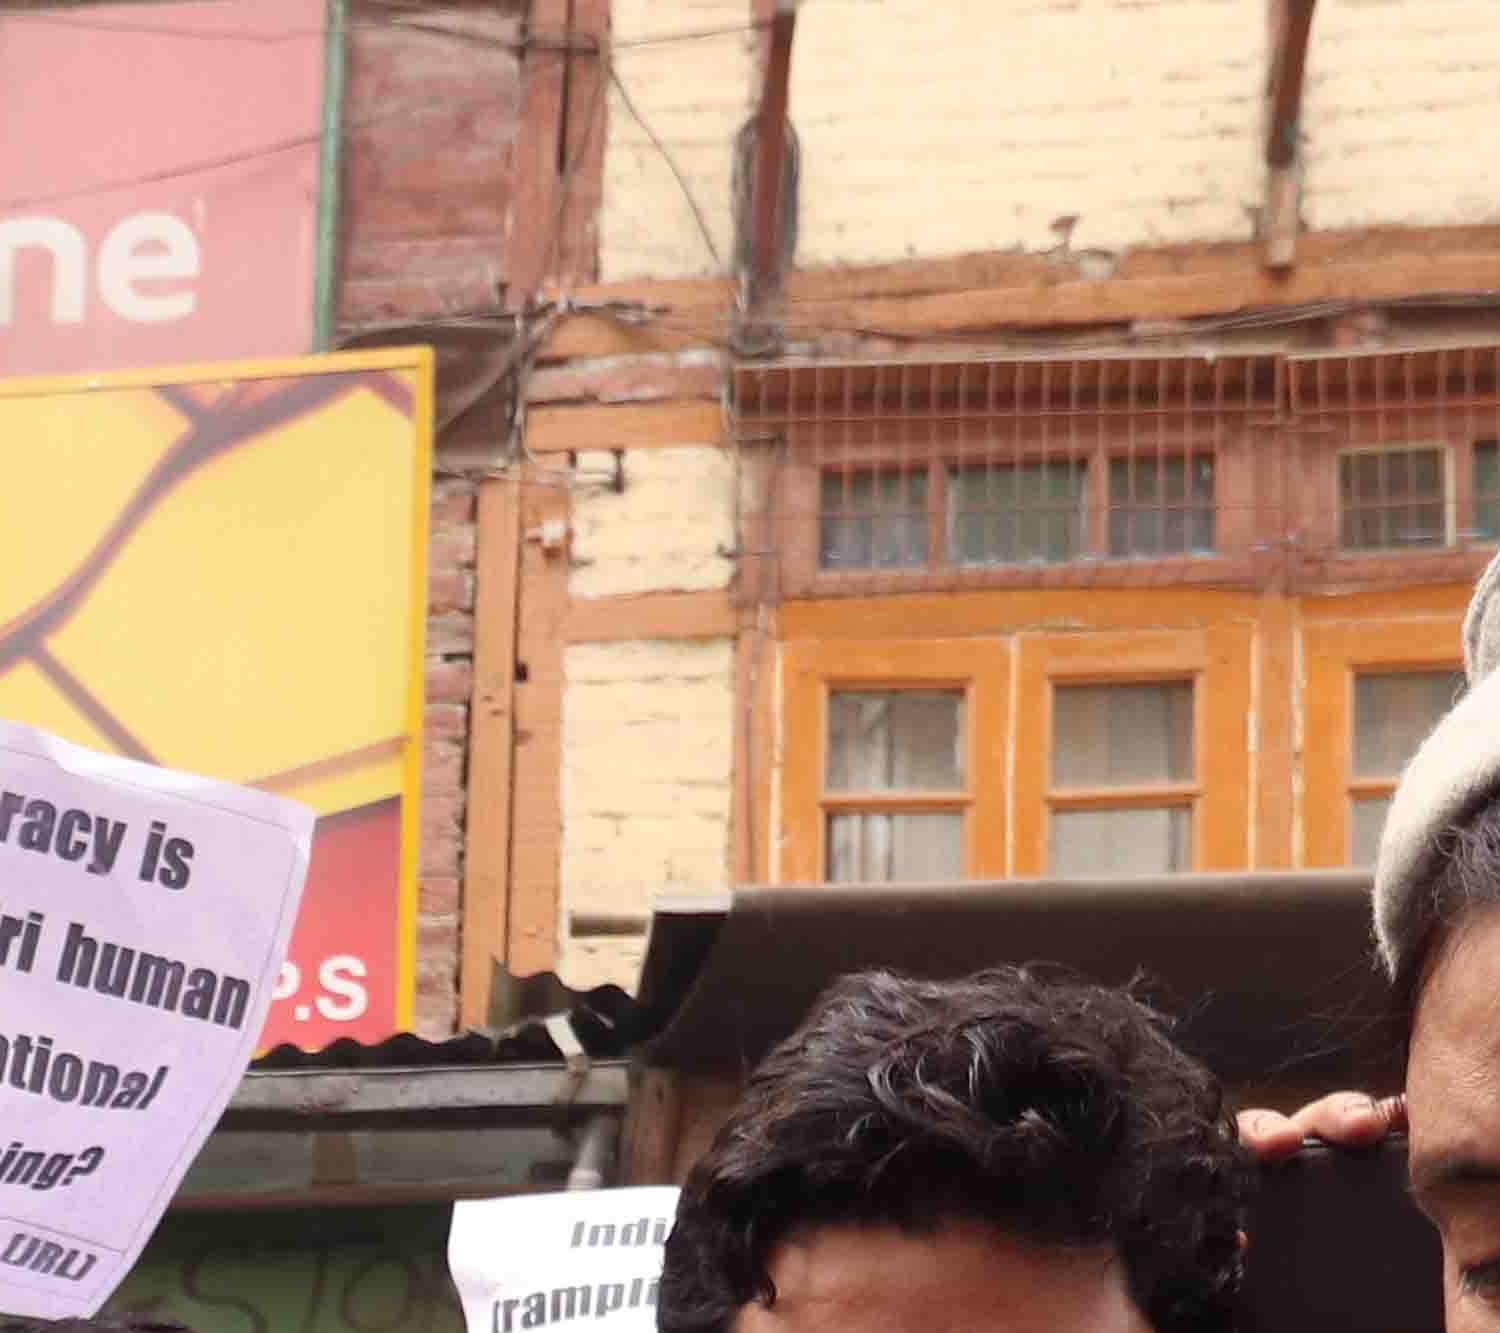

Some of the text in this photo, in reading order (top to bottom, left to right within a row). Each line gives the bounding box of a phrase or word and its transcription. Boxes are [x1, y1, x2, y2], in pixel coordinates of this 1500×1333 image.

[139, 822, 195, 891] is
[56, 920, 252, 1031] human
[570, 1217, 667, 1248] Indi
